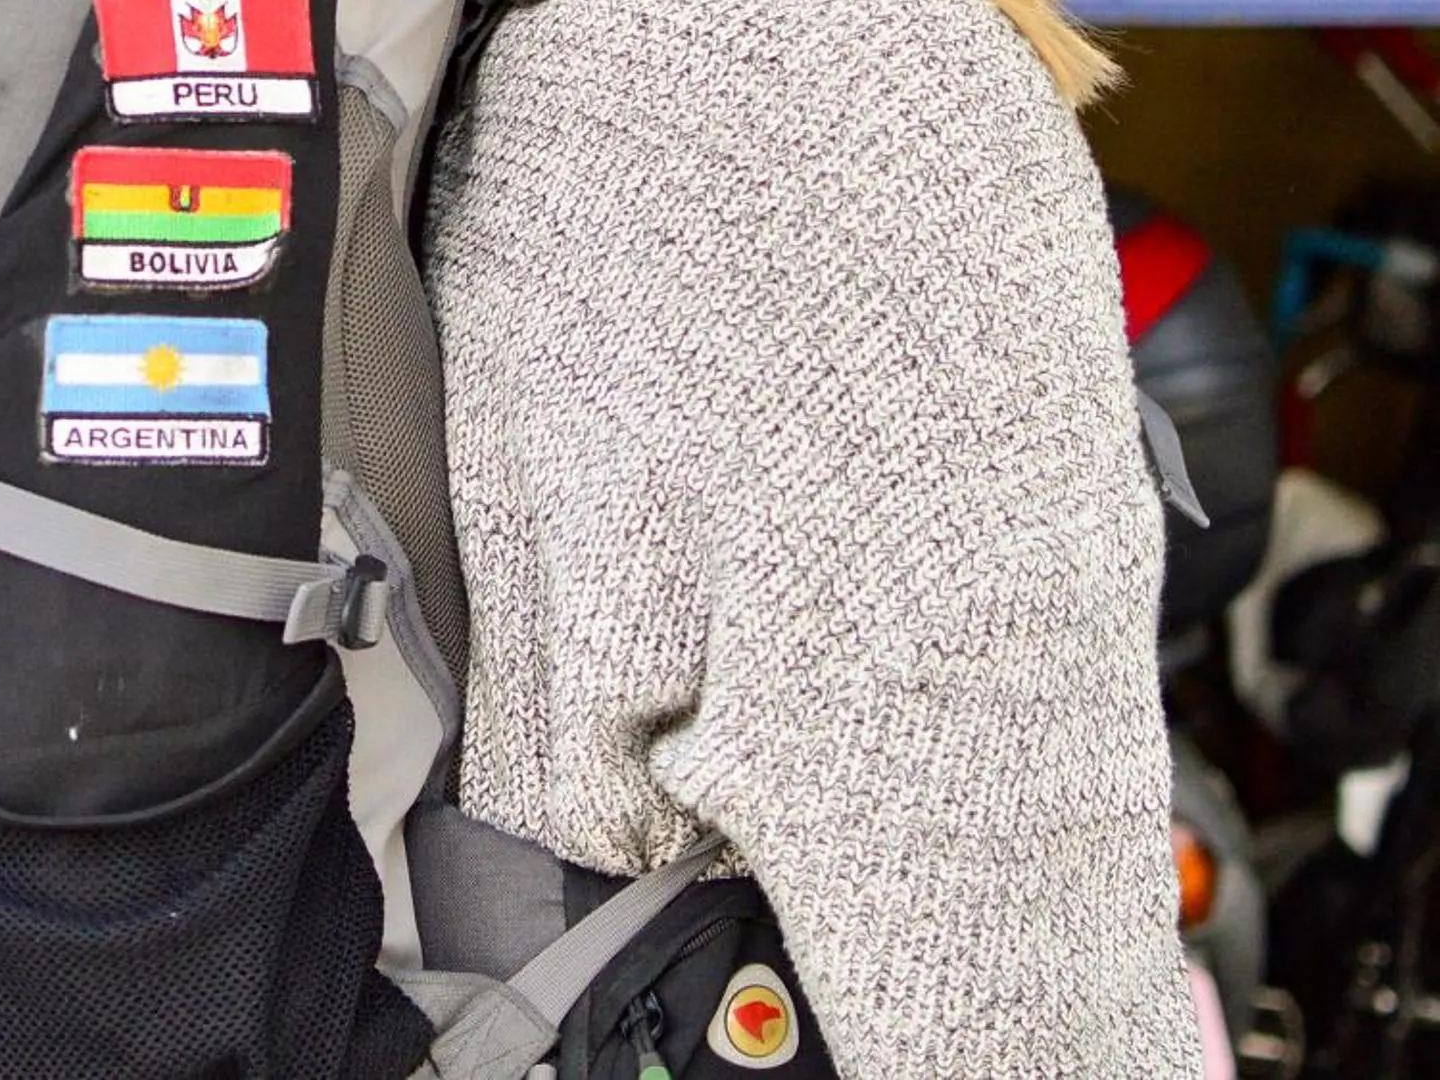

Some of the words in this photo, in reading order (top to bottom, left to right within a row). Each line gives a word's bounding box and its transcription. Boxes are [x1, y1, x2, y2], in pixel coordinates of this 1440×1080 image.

[172, 81, 258, 107] PERU
[129, 249, 239, 275] BOLIVIA
[65, 426, 248, 450] ARGENTINA
